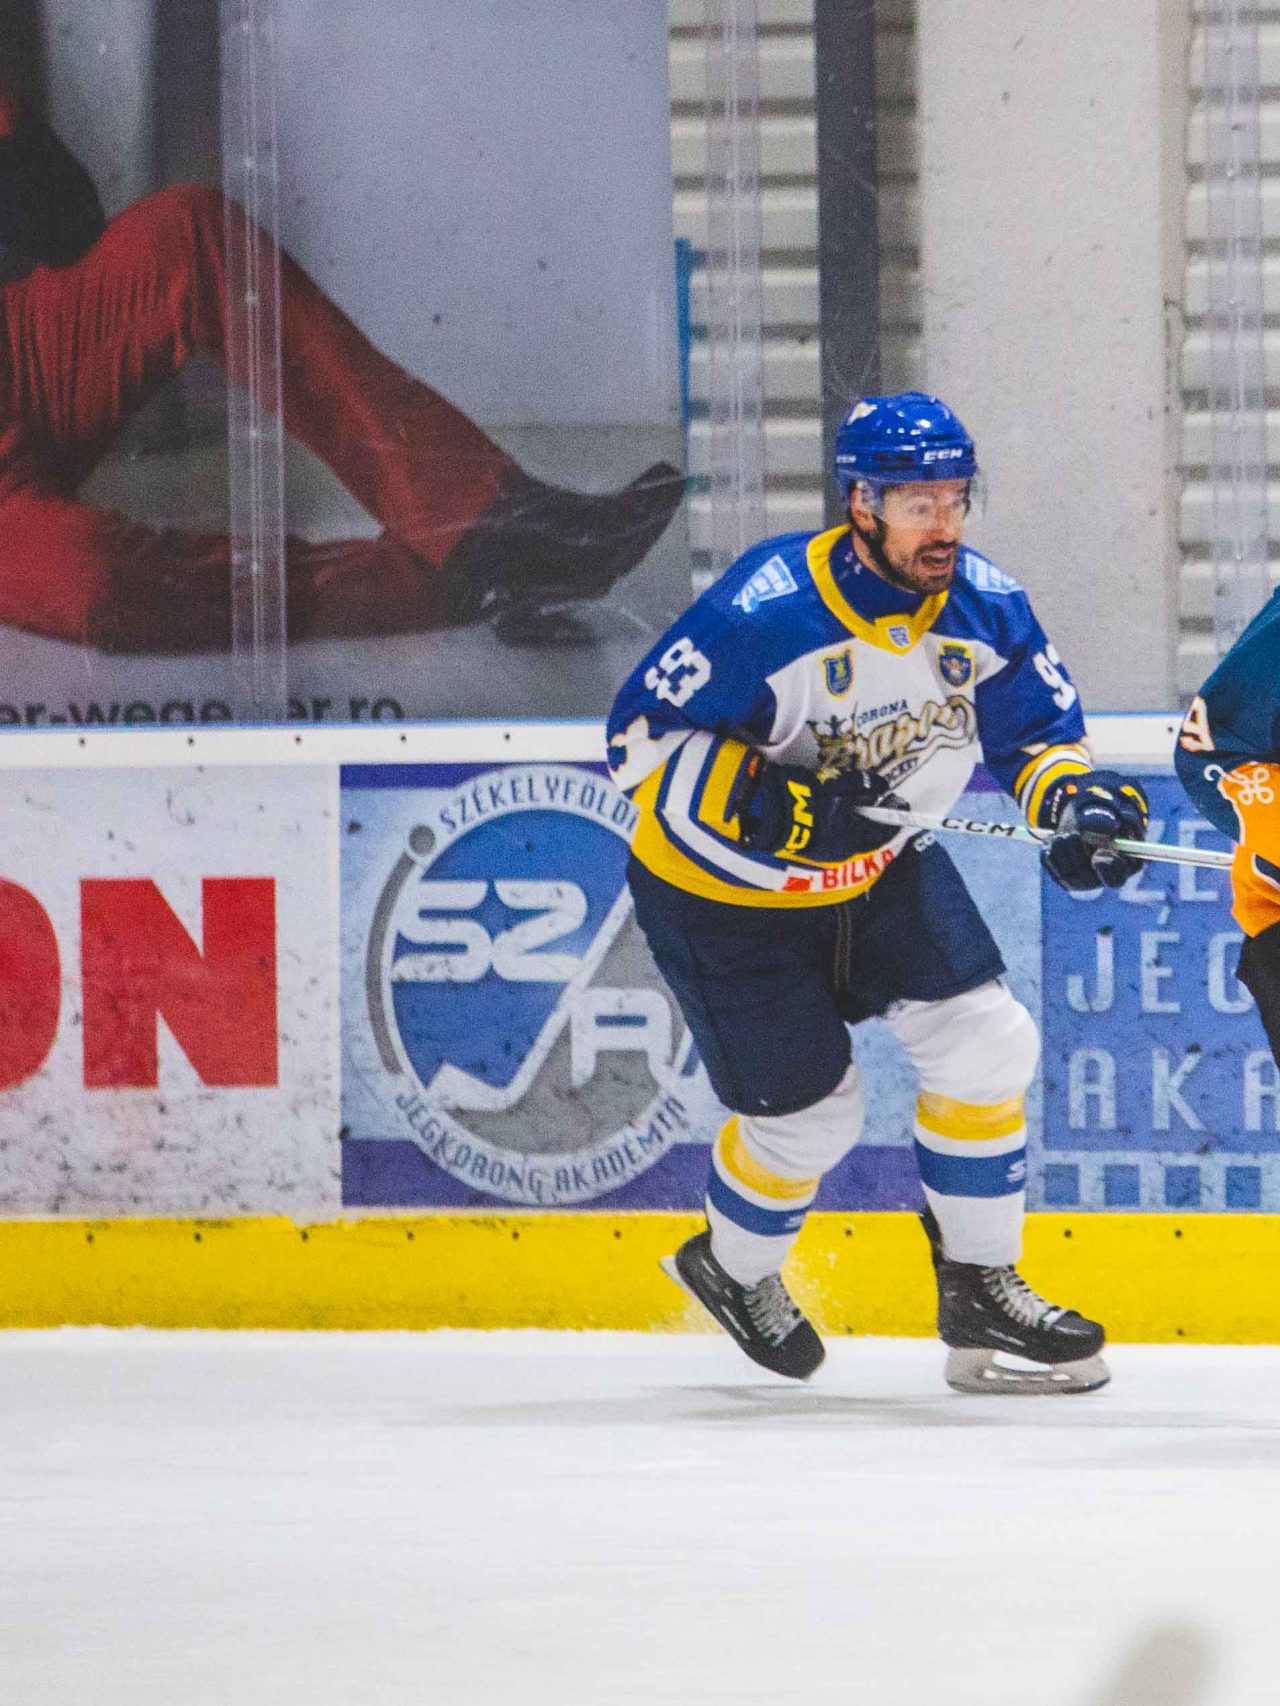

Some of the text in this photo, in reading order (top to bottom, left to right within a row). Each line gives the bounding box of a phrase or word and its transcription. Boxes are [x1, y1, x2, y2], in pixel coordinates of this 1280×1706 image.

[923, 449, 963, 464] CCM
[645, 636, 712, 707] 93
[1179, 696, 1216, 752] 9
[942, 817, 1016, 837] CCM
[822, 848, 896, 891] BILKA
